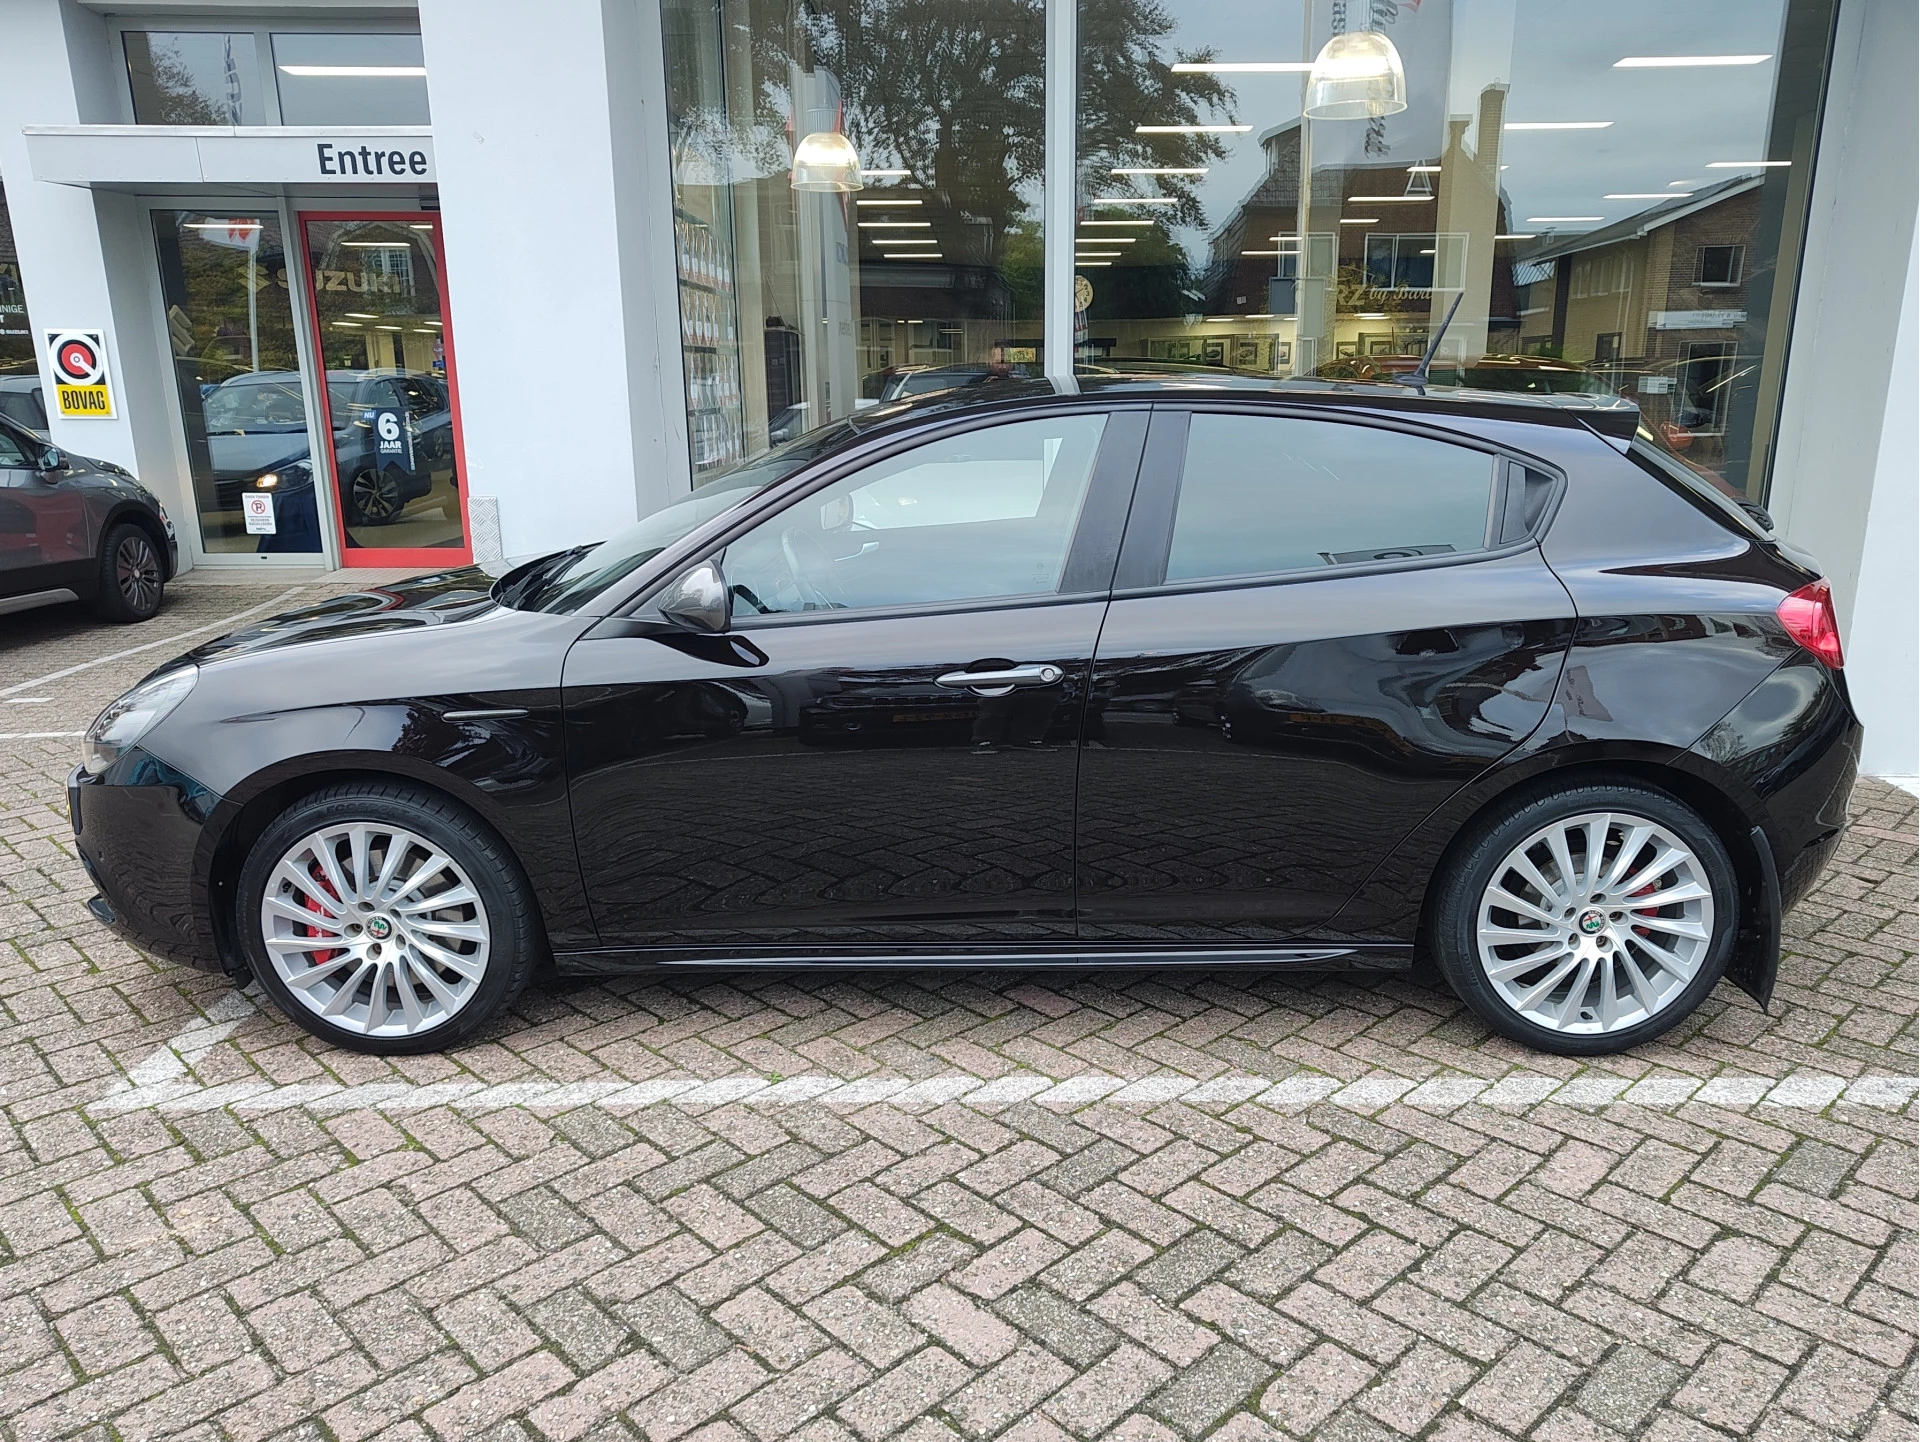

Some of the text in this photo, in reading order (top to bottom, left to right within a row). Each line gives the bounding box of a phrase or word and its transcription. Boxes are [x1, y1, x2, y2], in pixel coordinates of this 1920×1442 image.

[317, 143, 428, 175] Entree
[62, 390, 106, 410] BOVAG
[378, 412, 400, 441] 6
[379, 441, 402, 449] JAAR
